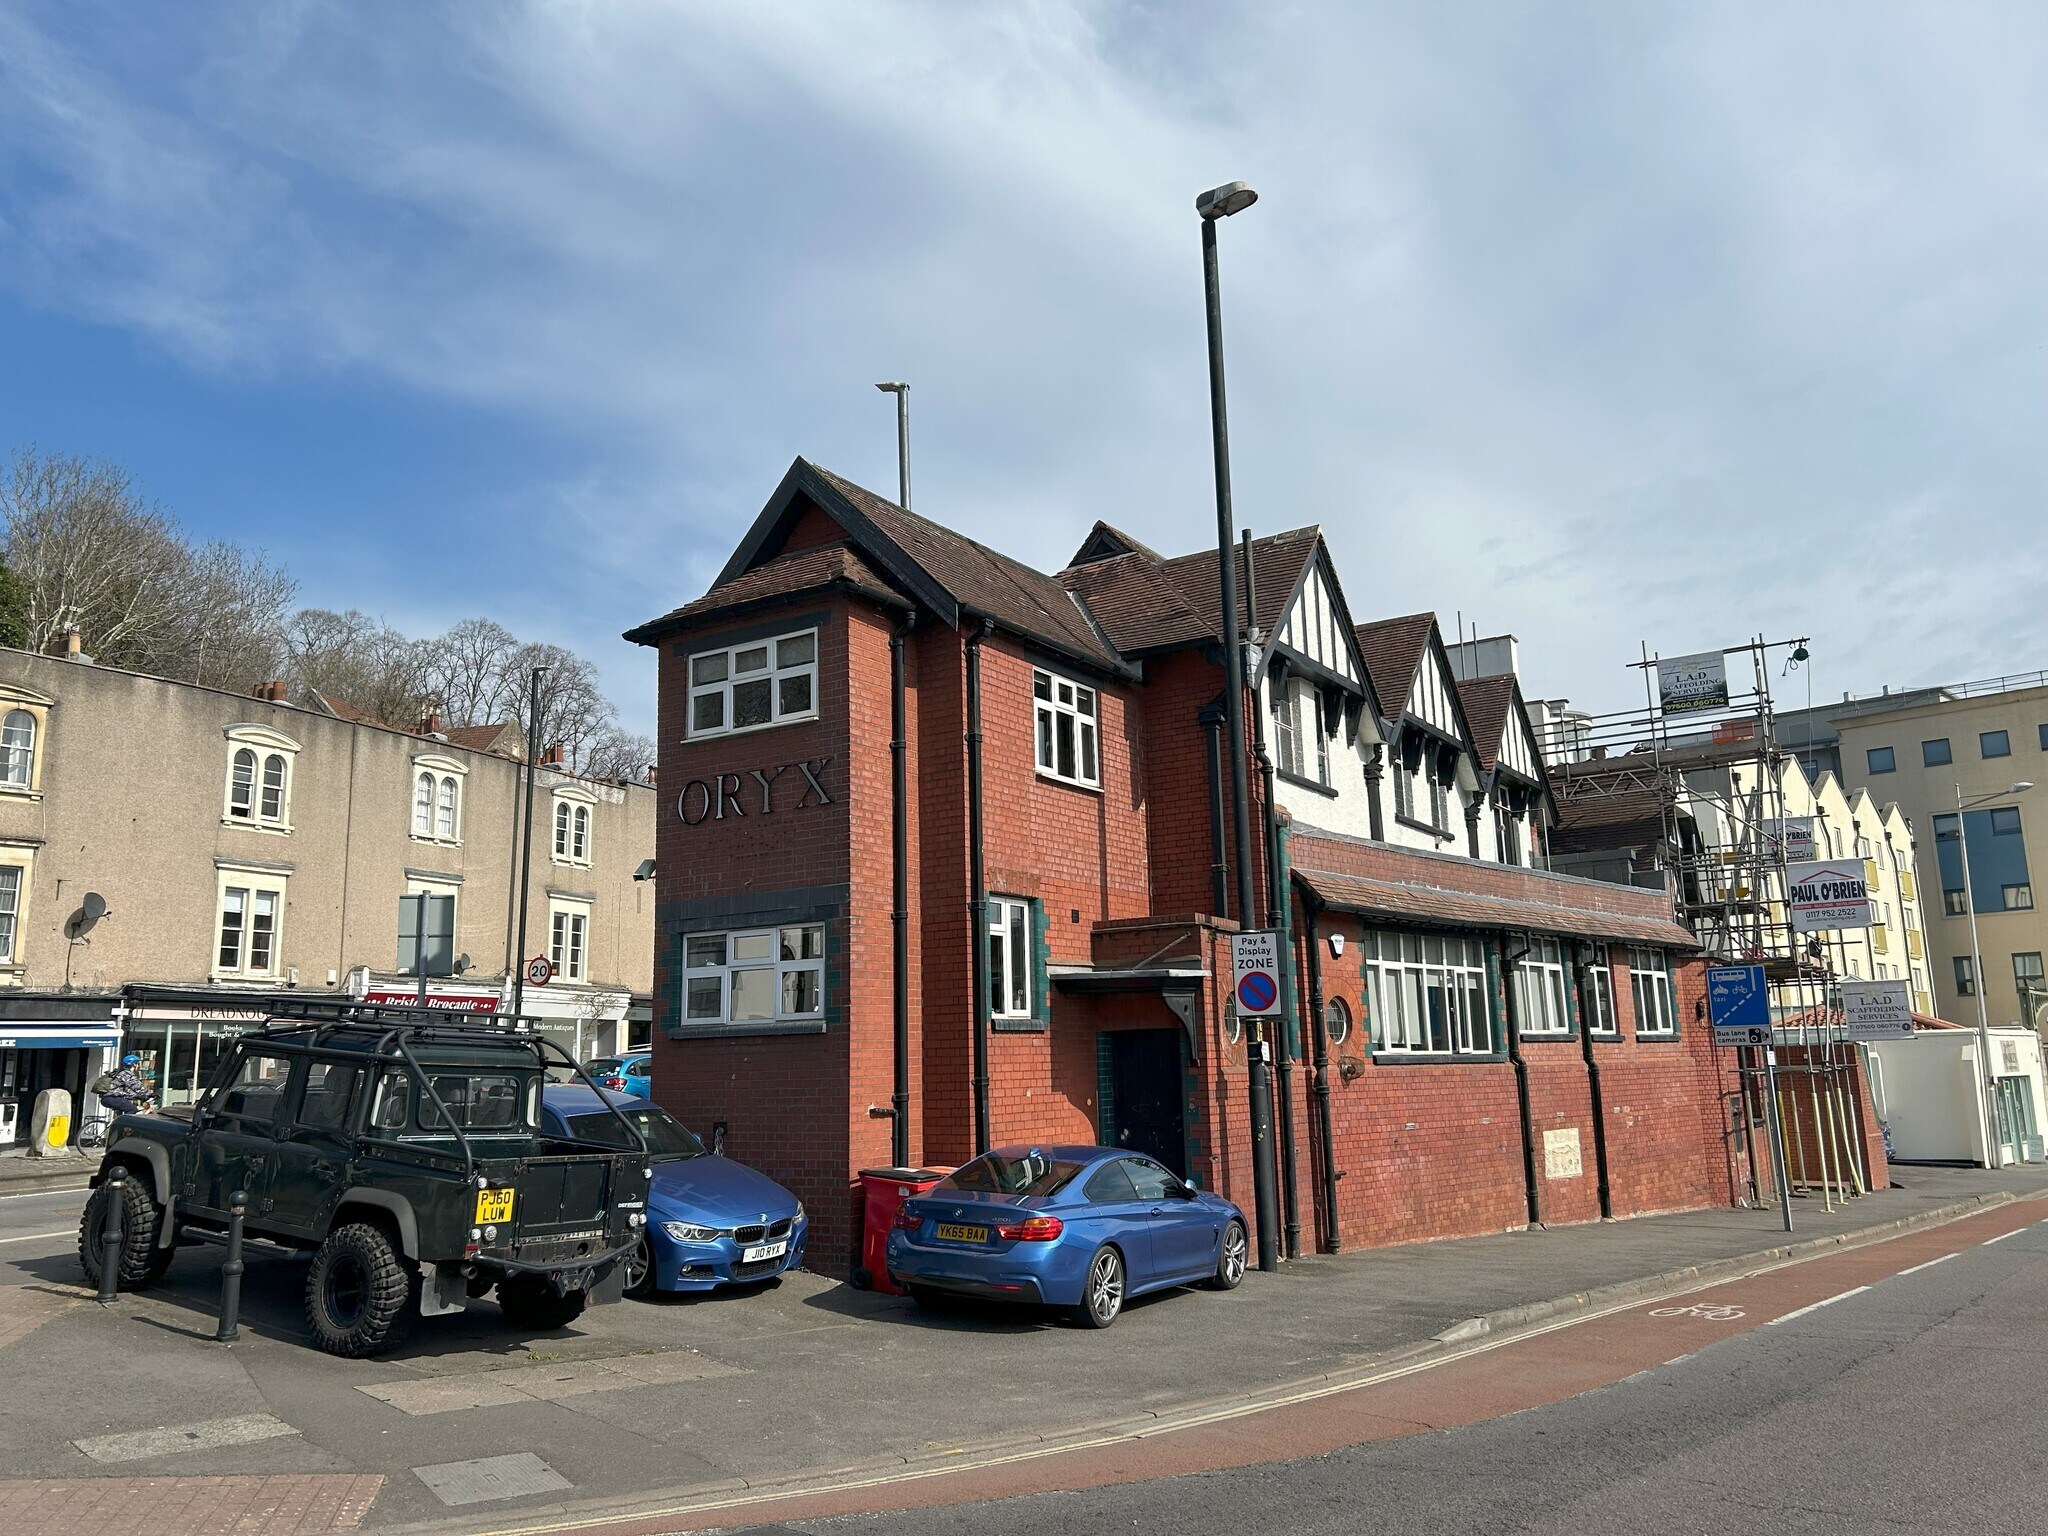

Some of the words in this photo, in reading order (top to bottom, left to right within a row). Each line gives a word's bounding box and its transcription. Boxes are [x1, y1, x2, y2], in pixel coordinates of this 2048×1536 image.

[1676, 672, 1706, 682] L.A.D
[1663, 678, 1721, 690] SCAFFOLDING
[1673, 686, 1712, 695] SERVICES
[1666, 702, 1691, 710] 07500
[677, 756, 835, 826] ORYX
[1790, 884, 1819, 903] PAUL
[1821, 880, 1867, 901] O'BRIEN
[1805, 911, 1820, 919] 0117
[1821, 909, 1836, 917] 952
[1837, 908, 1856, 916] 2522
[1241, 937, 1257, 946] Pay
[1260, 936, 1267, 944] &
[1238, 947, 1271, 956] Display
[1238, 958, 1274, 969] ZONE
[531, 965, 547, 977] 20
[384, 996, 427, 1007] Brist
[427, 998, 477, 1010] Brocante
[1859, 996, 1892, 1006] L.A.D
[190, 1006, 267, 1019] DREADNOU
[1847, 1005, 1908, 1014] SCAFFOLDING
[1857, 1012, 1899, 1020] SERVICES
[532, 1023, 552, 1031] Modern
[553, 1023, 575, 1032] Antiques
[208, 1031, 232, 1039] Bought
[480, 1191, 511, 1206] PJ60
[482, 1207, 506, 1221] LUW
[940, 1225, 964, 1238] YK65
[966, 1228, 985, 1241] BAA
[765, 1243, 781, 1257] RYX
